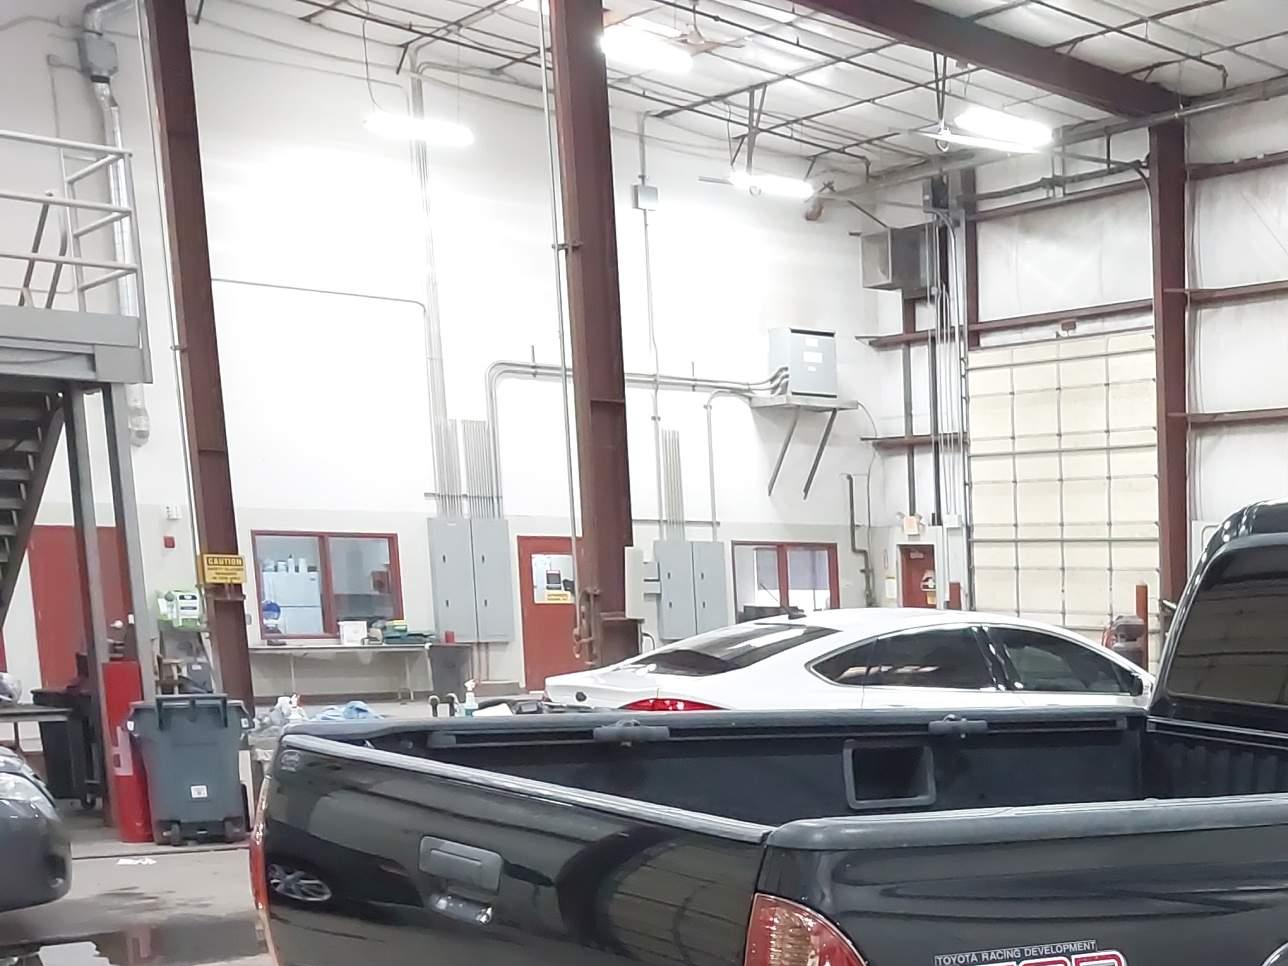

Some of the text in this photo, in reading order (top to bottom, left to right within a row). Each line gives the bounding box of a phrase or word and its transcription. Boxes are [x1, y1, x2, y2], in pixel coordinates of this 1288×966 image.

[207, 557, 243, 566] CAUTION
[936, 940, 1096, 966] TOYOTA RACING DEVELOPMENT
